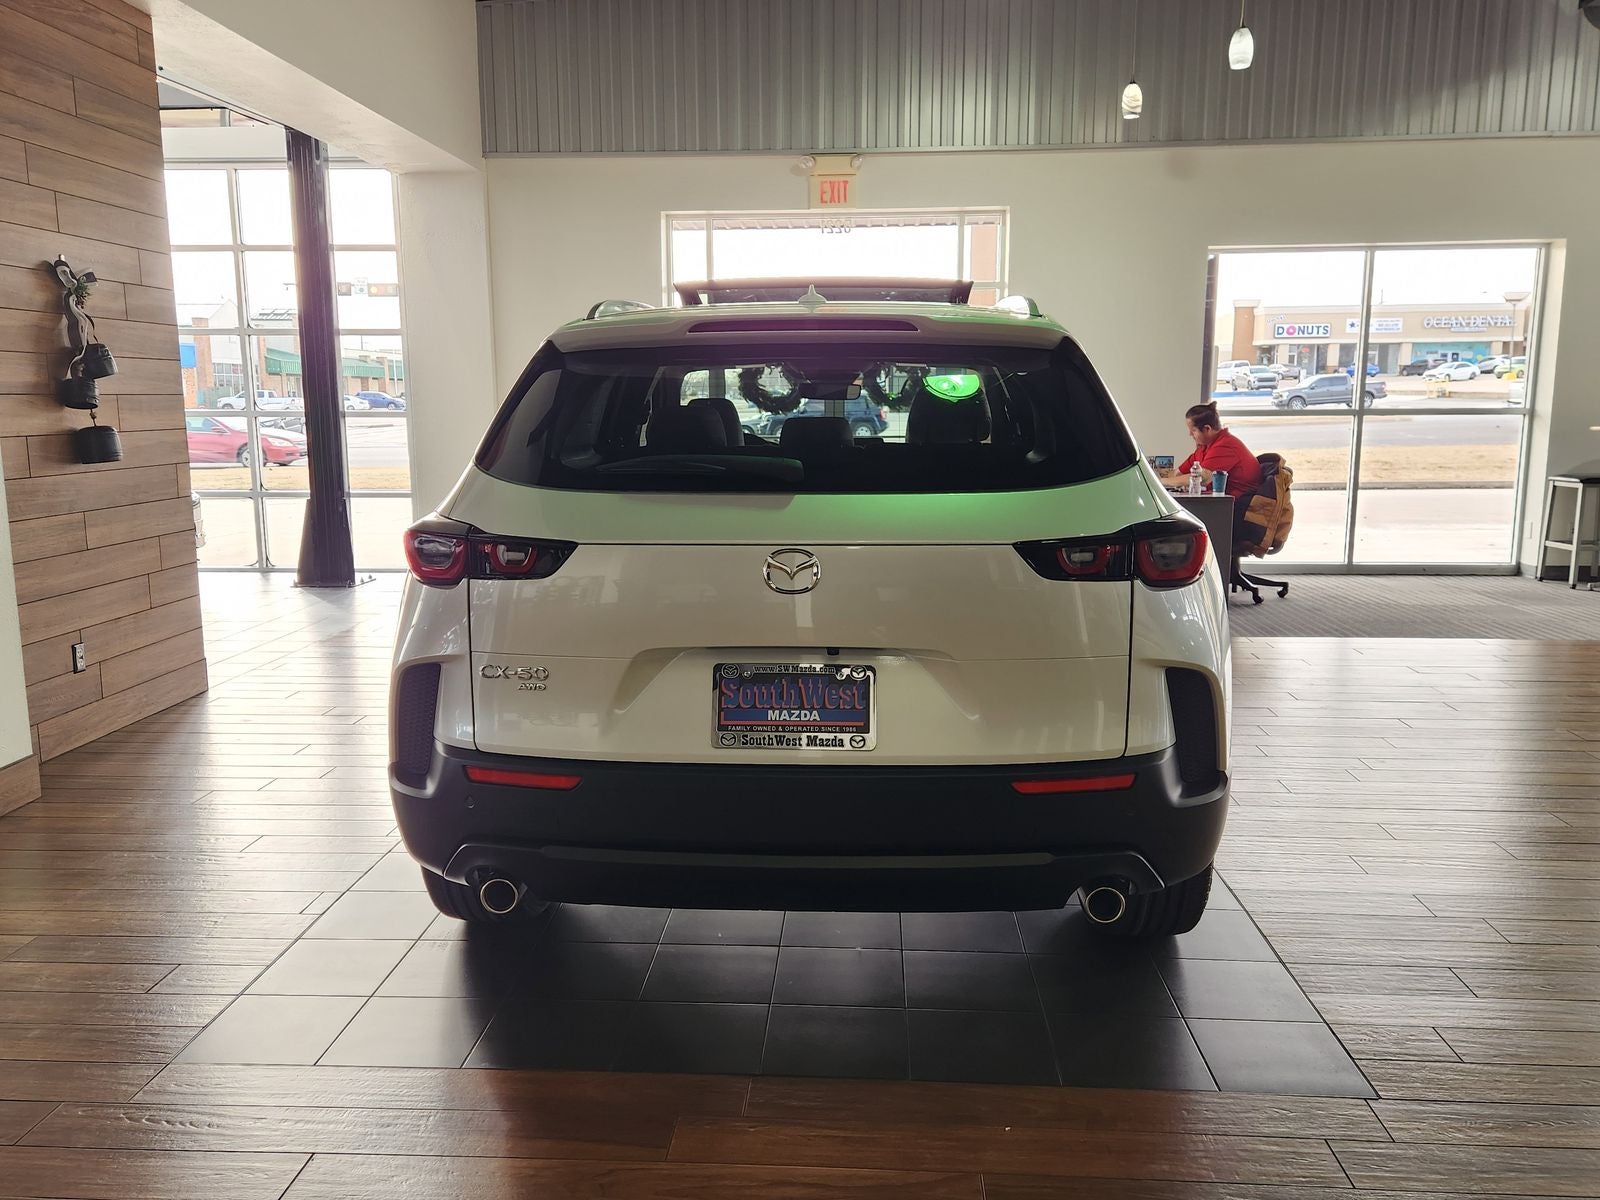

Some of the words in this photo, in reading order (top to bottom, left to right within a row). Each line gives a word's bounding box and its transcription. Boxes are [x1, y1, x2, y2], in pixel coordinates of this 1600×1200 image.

[819, 180, 849, 204] EXIT
[1424, 316, 1466, 328] OCEAN
[1276, 325, 1329, 336] DONUTS
[479, 665, 549, 681] CX-50
[754, 664, 835, 673] www.SWMazda.com
[518, 683, 546, 691] AWD
[721, 676, 865, 709] SouthWest
[767, 710, 820, 721] MAZDA
[741, 734, 803, 747] SouthWest
[806, 735, 845, 748] Mazda
